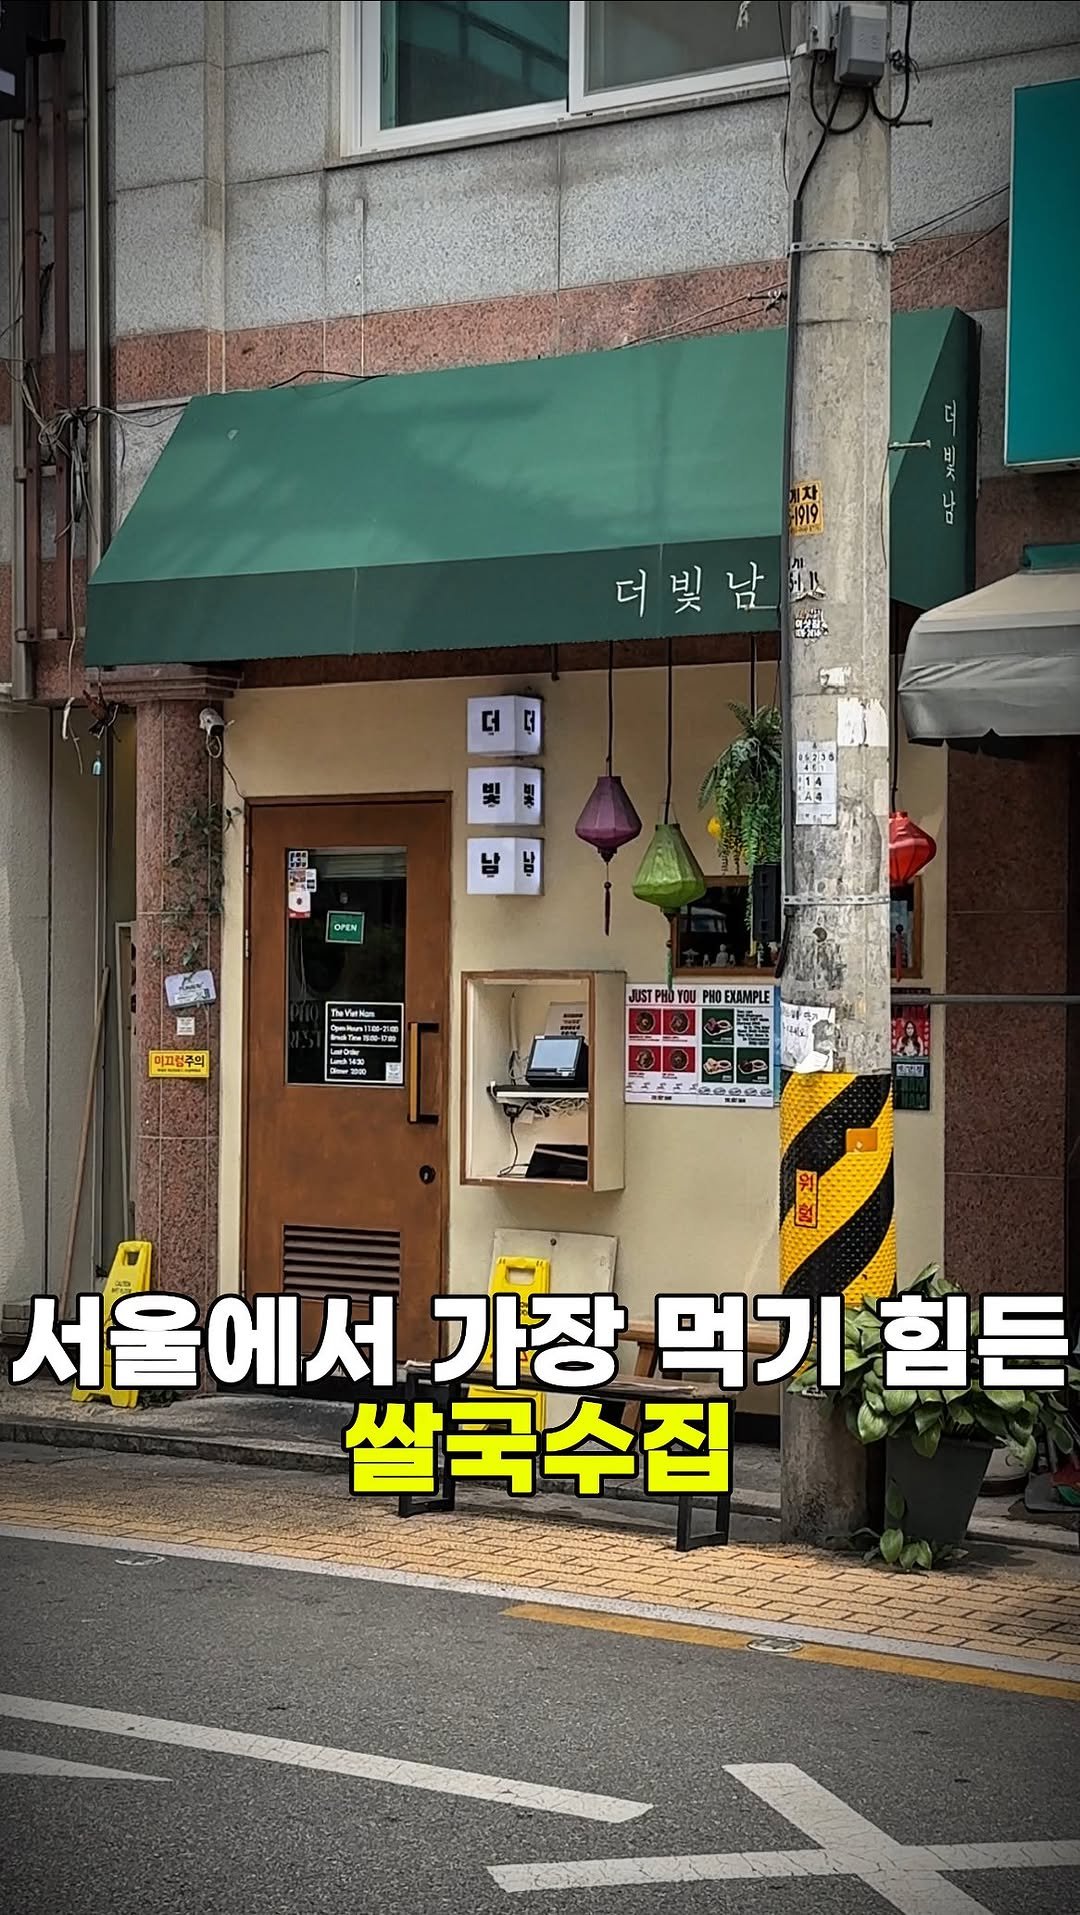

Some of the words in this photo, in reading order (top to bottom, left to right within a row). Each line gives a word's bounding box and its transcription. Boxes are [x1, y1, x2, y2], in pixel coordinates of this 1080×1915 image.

[334, 924, 358, 932] OPEN
[628, 988, 653, 1003] JUST
[654, 989, 675, 1004] PHO
[677, 989, 697, 1004] YOU
[702, 989, 722, 1004] PHO
[724, 990, 770, 1004] EXAMPLE
[330, 1008, 344, 1017] The
[344, 1008, 359, 1018] Viet
[330, 1024, 346, 1032] Open
[346, 1024, 363, 1032] Hours
[330, 1033, 347, 1041] Break
[330, 1048, 343, 1056] Last
[343, 1048, 360, 1056] Order
[154, 1054, 205, 1068] 미끄럼주의
[330, 1058, 348, 1066] Lunch
[330, 1067, 349, 1075] Dinner
[799, 1172, 814, 1223] 위험
